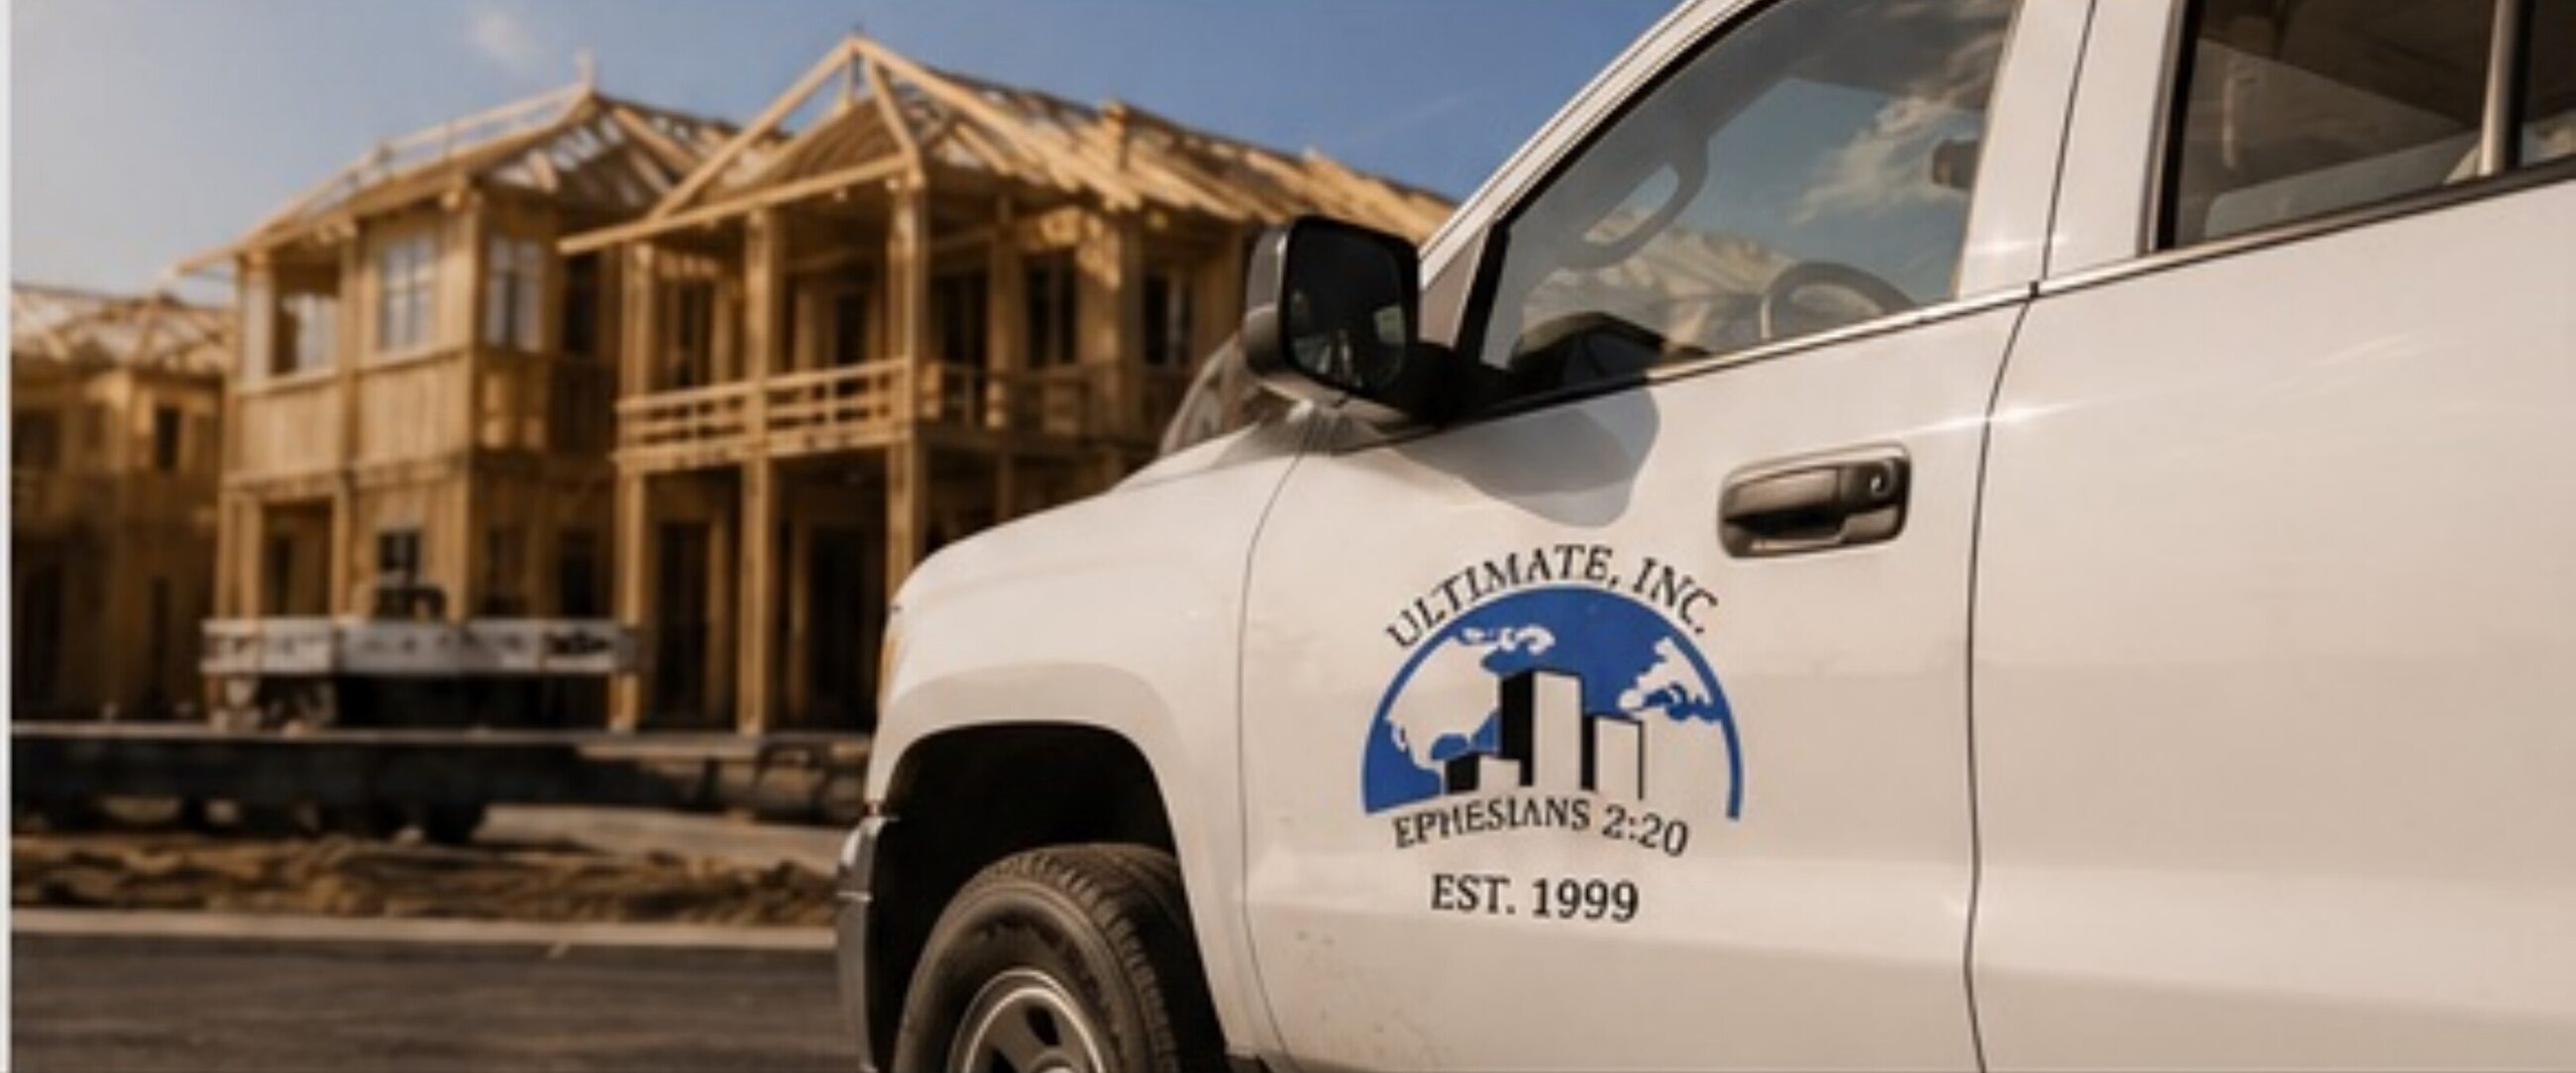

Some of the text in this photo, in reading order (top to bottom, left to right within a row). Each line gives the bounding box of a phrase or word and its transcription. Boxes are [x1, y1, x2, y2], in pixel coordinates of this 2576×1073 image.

[1386, 545, 1718, 649] ULTIMATE, INC.
[1393, 798, 1690, 857] EPHESIANS 2:20
[1431, 874, 1640, 922] EST. 1999
